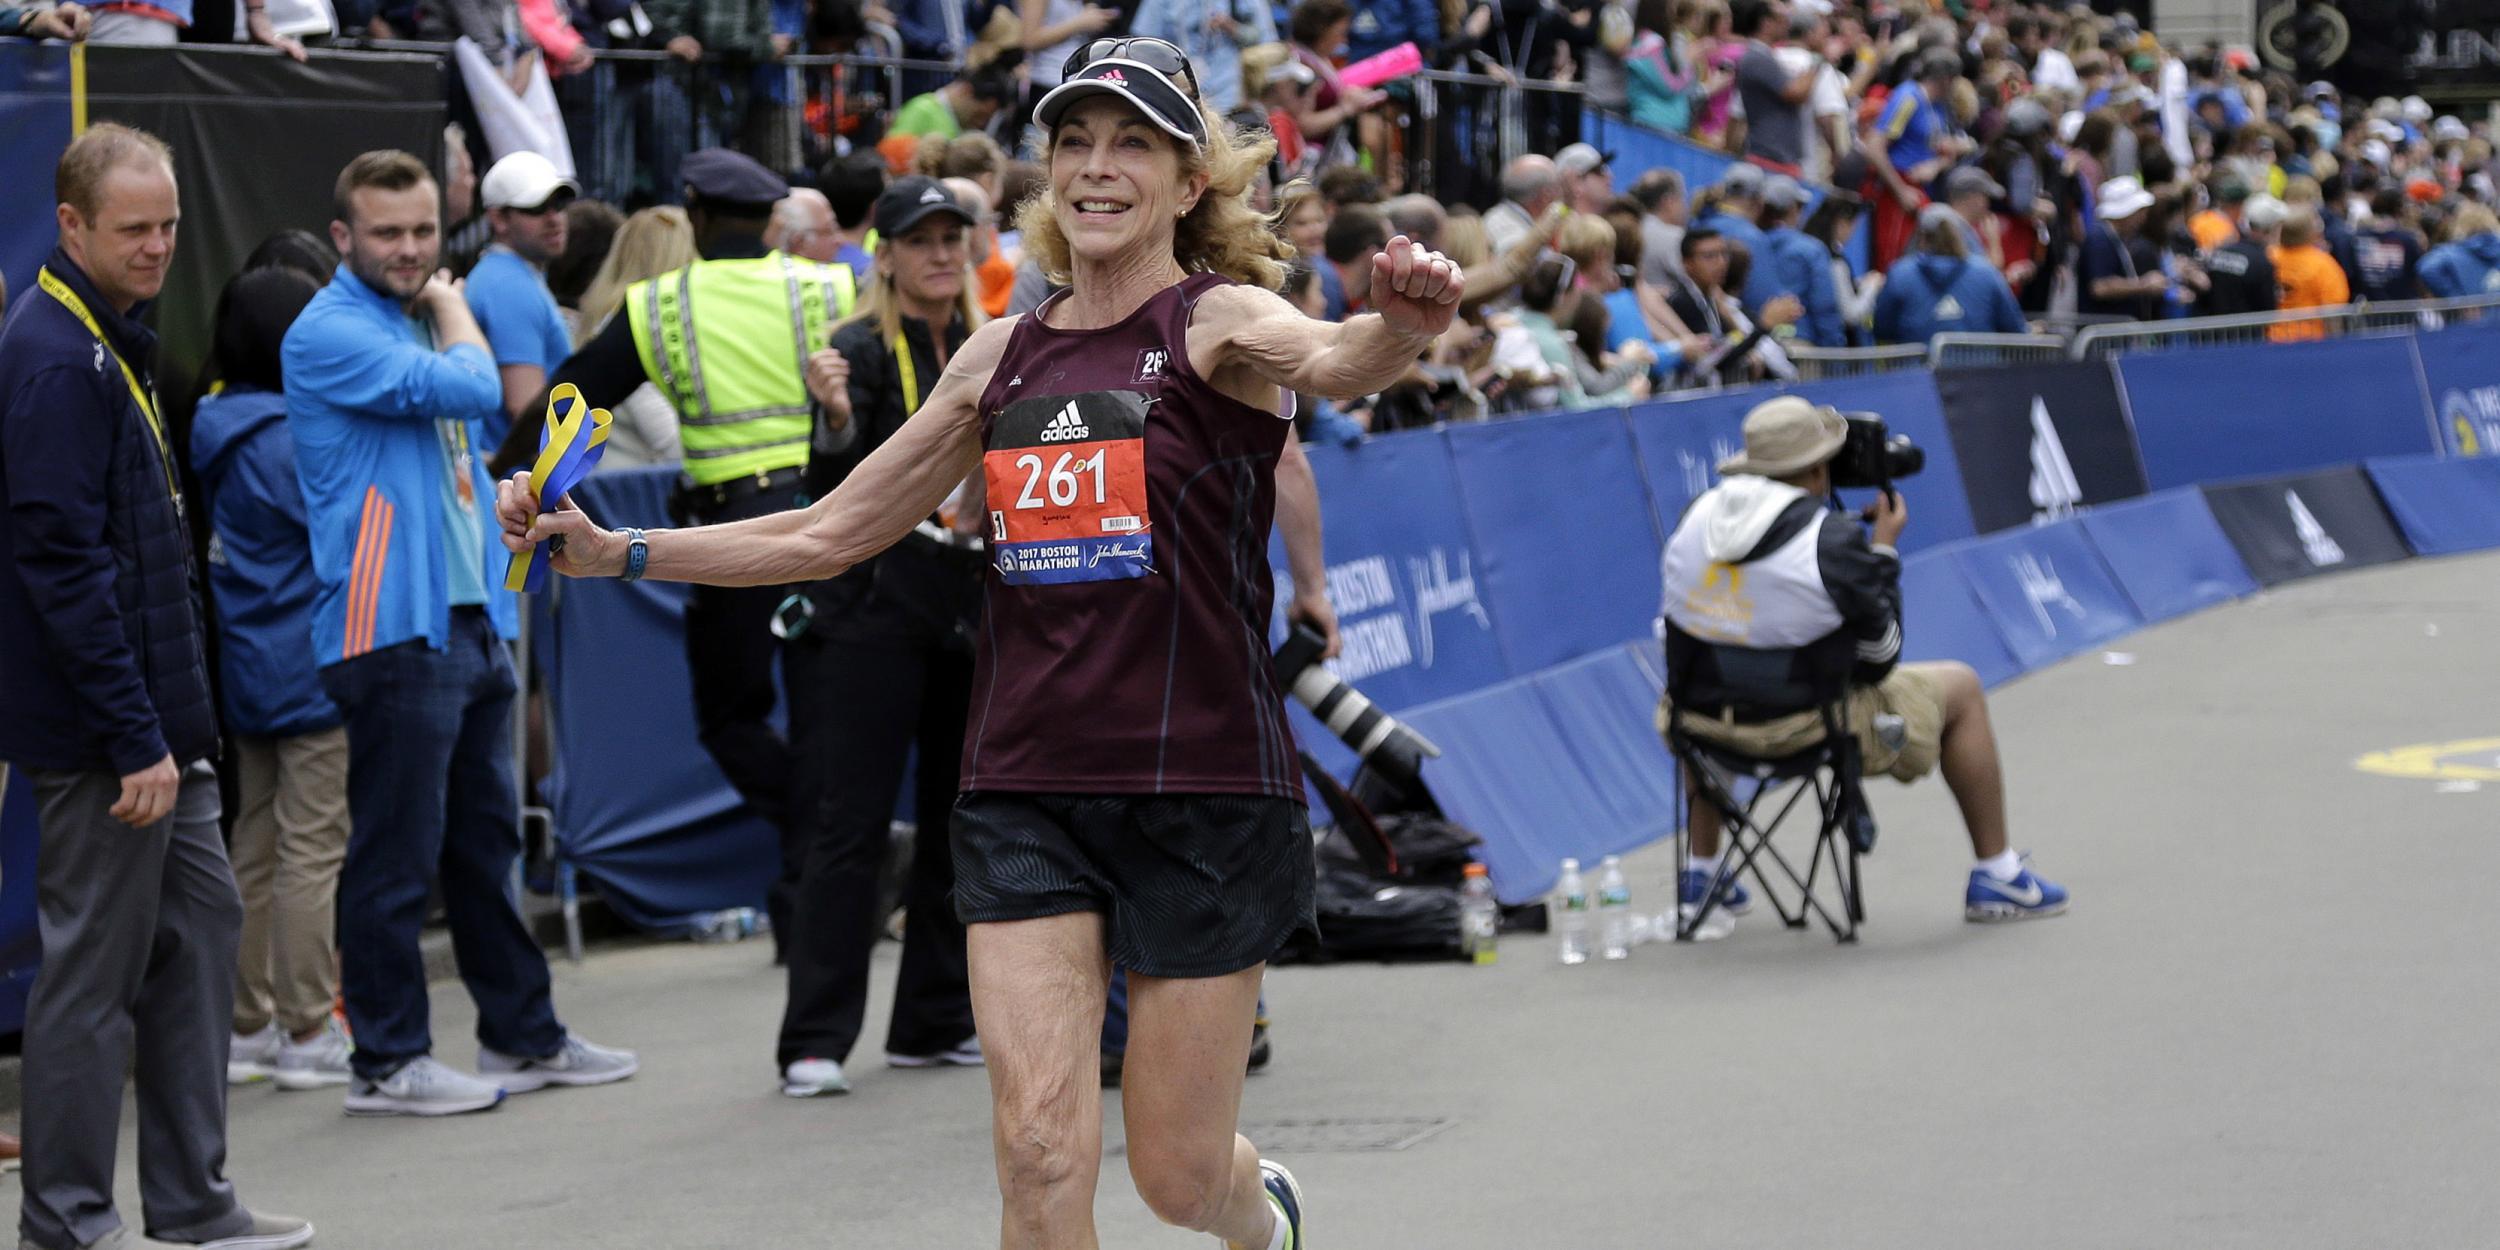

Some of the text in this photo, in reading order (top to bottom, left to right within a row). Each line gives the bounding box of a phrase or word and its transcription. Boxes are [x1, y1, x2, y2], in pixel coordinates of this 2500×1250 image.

[1040, 425, 1090, 443] adidas
[1015, 448, 1106, 510] 261
[1017, 548, 1039, 560] 2017
[1040, 545, 1079, 558] BOSTON
[1018, 558, 1080, 572] MARATHON
